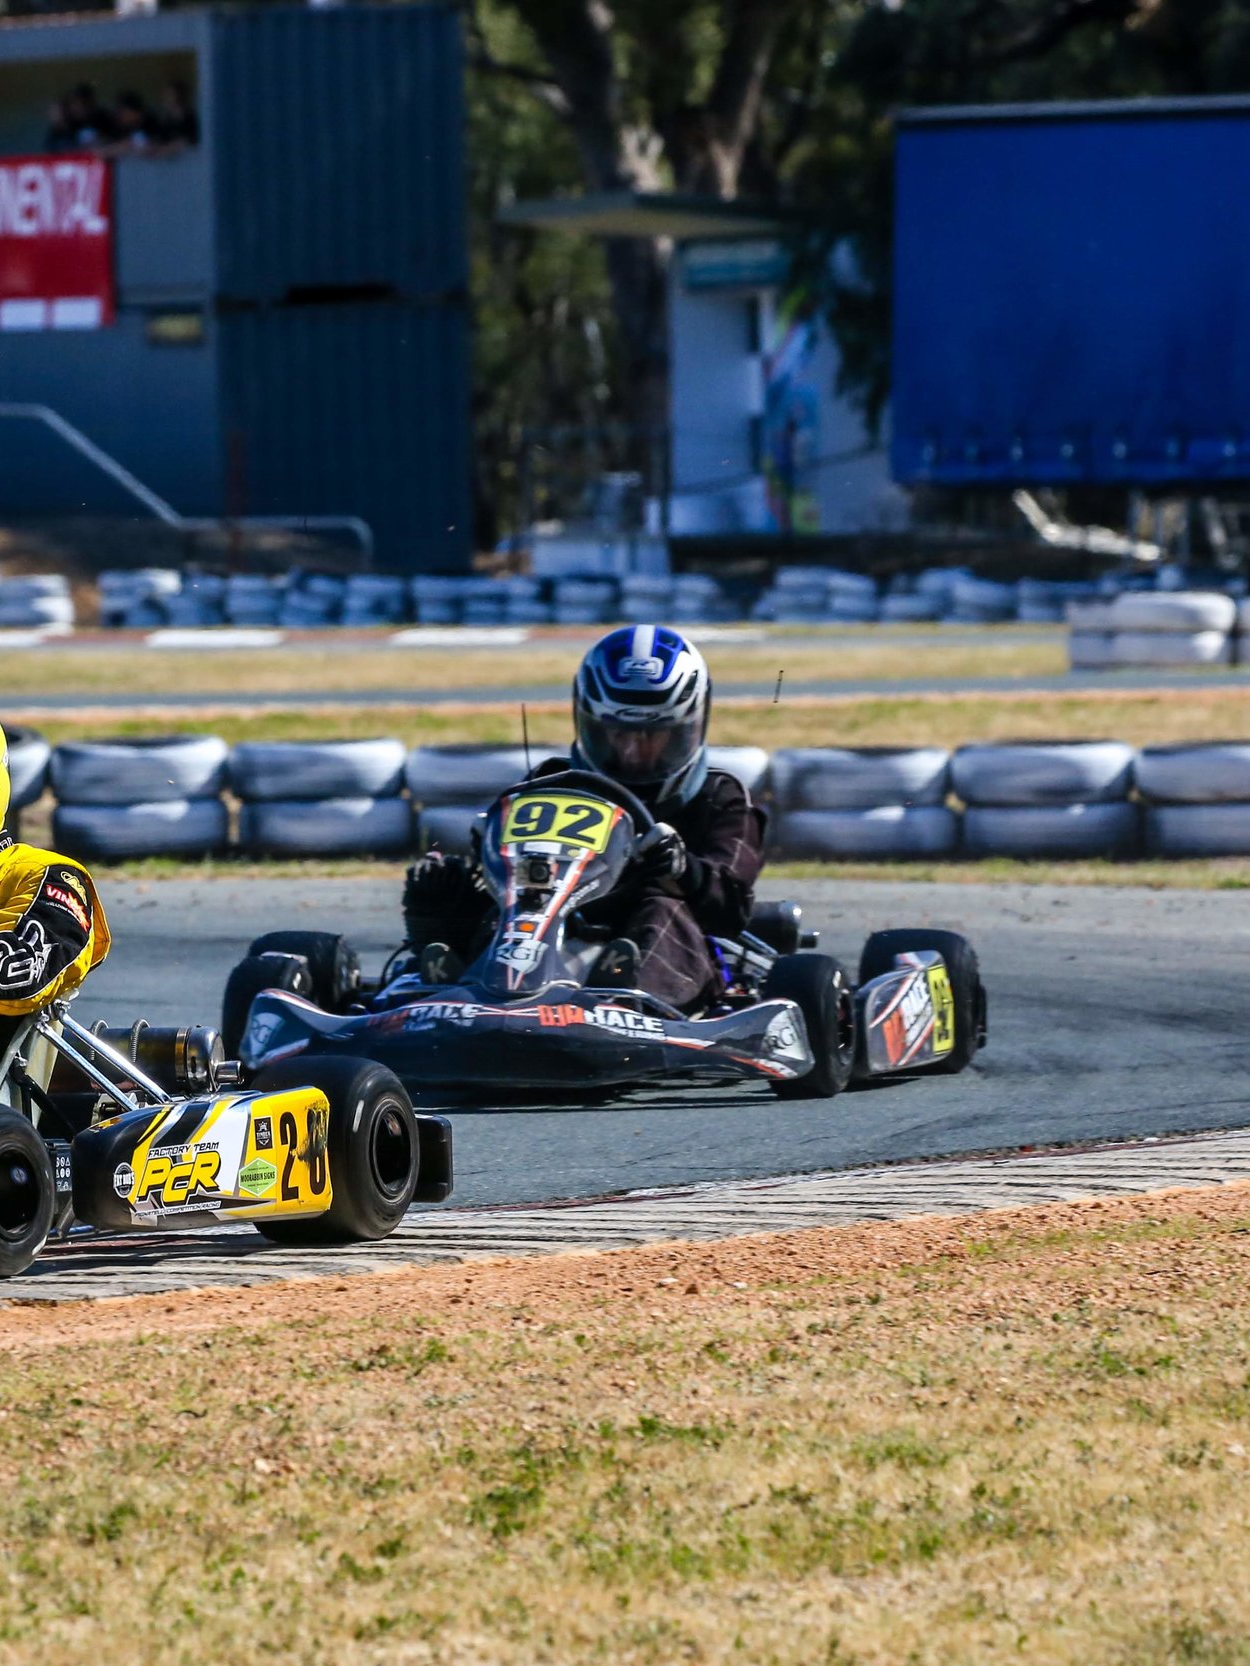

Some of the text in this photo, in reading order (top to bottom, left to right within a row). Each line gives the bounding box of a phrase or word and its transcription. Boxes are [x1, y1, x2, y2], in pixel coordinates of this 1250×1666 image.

[511, 801, 604, 845] 92
[148, 1142, 220, 1158] FACTORY TEAM
[137, 1151, 221, 1204] PCR
[264, 1171, 275, 1180] SIGNS
